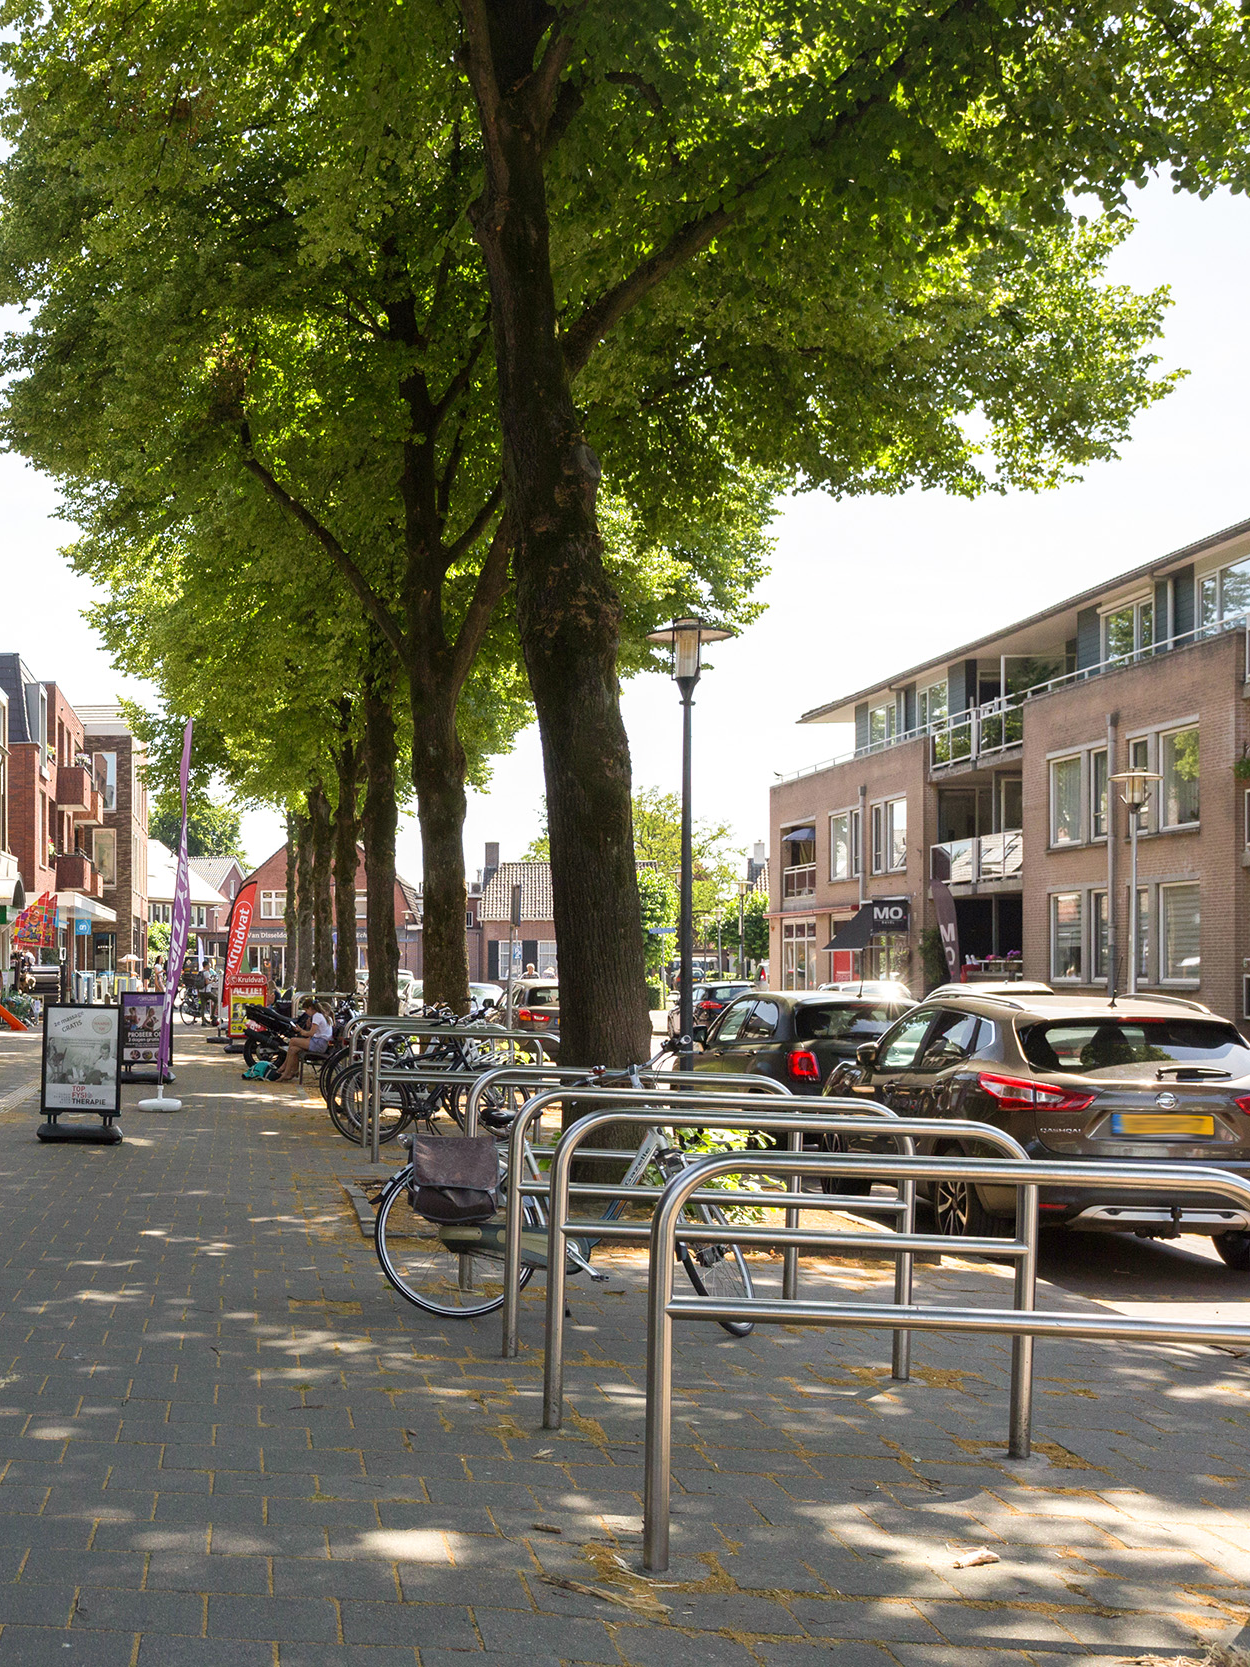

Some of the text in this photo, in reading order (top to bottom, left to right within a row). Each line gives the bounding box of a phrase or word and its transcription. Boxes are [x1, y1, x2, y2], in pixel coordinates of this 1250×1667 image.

[227, 907, 250, 969] Kruidvat
[60, 1010, 84, 1025] massage
[61, 1020, 83, 1032] GRATIS
[625, 1147, 651, 1186] Gazelle
